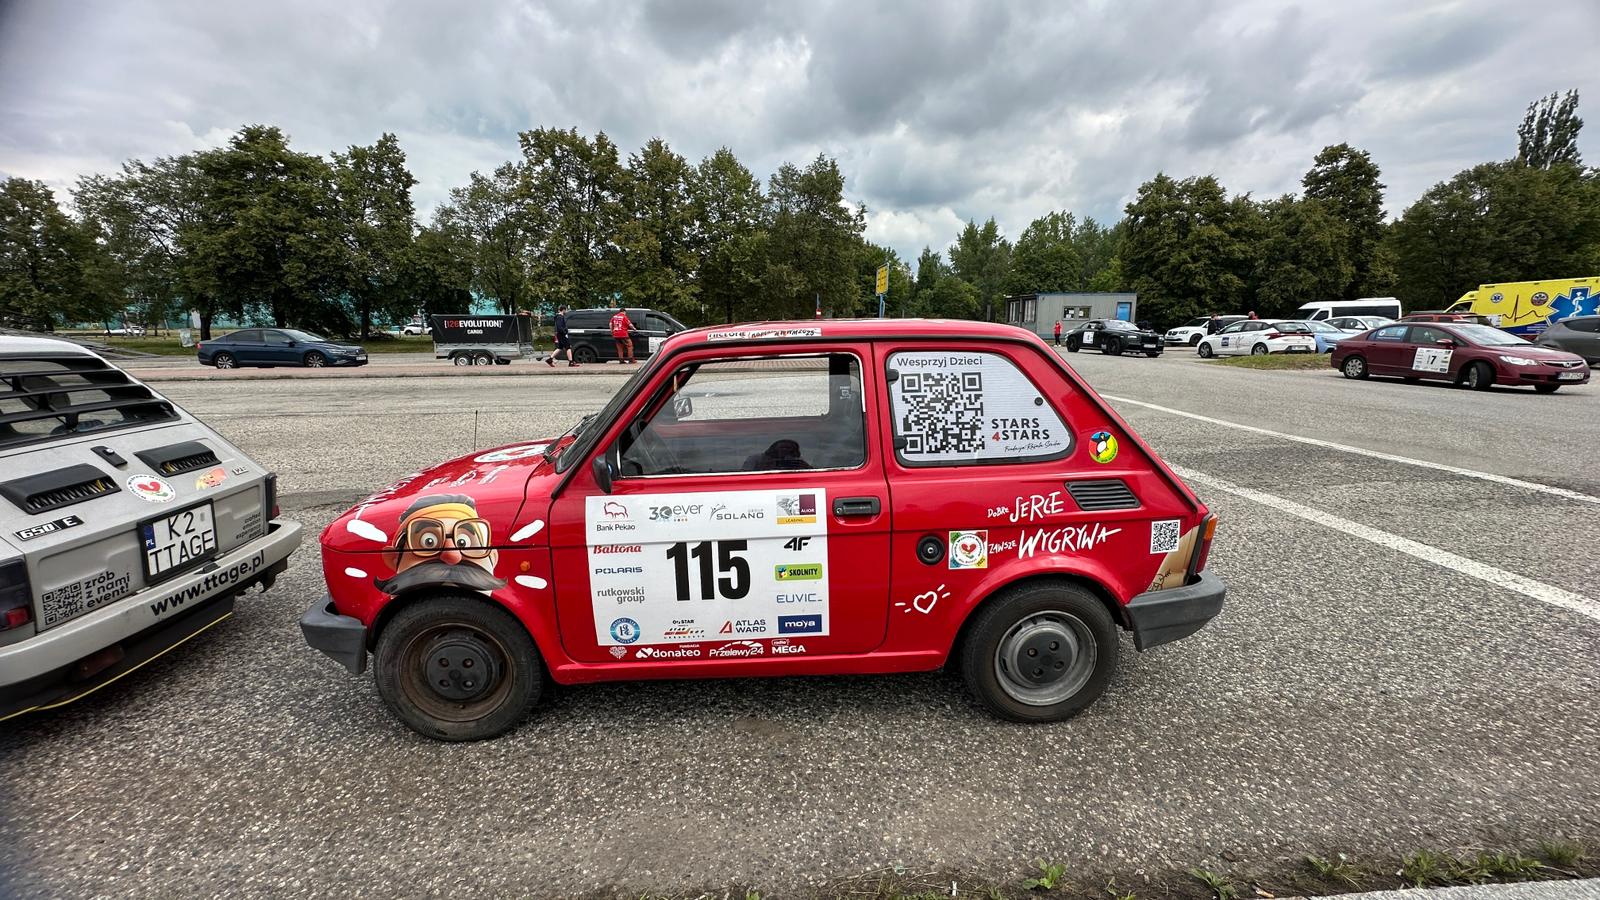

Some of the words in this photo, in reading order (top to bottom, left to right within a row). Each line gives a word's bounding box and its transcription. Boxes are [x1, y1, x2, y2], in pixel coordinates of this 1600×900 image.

[897, 357, 947, 368] Wesprzyj
[950, 356, 983, 366] Dzieci
[1431, 355, 1437, 365] 7
[991, 418, 1040, 429] STARS
[991, 429, 1050, 442] 4STARS
[1009, 491, 1064, 522] SERCE
[716, 511, 765, 521] SOLANO
[19, 522, 56, 539] 650
[62, 516, 78, 527] E
[168, 514, 181, 540] K
[183, 511, 196, 535] 2
[596, 524, 614, 532] Bank
[615, 523, 636, 532] Pekao
[145, 539, 155, 547] PL
[783, 536, 812, 551] 4F
[988, 540, 1018, 554] ZAWSZE
[1018, 522, 1122, 560] WYGRYWA
[149, 529, 215, 573] TTAGE
[593, 544, 642, 554] Baltona
[595, 566, 643, 575] POLARIS
[666, 540, 751, 602] 115
[789, 567, 818, 577] SKOLNITY
[84, 571, 115, 590] zrób
[86, 590, 94, 600] z
[97, 572, 131, 592] nami
[150, 549, 265, 617] www.ttage.pl
[86, 583, 130, 608] event!
[597, 586, 645, 597] rutkowski
[616, 594, 645, 605] group
[735, 619, 766, 627] ATLAS
[784, 619, 816, 629] moya
[652, 648, 701, 658] donateo
[771, 645, 806, 654] MEGA
